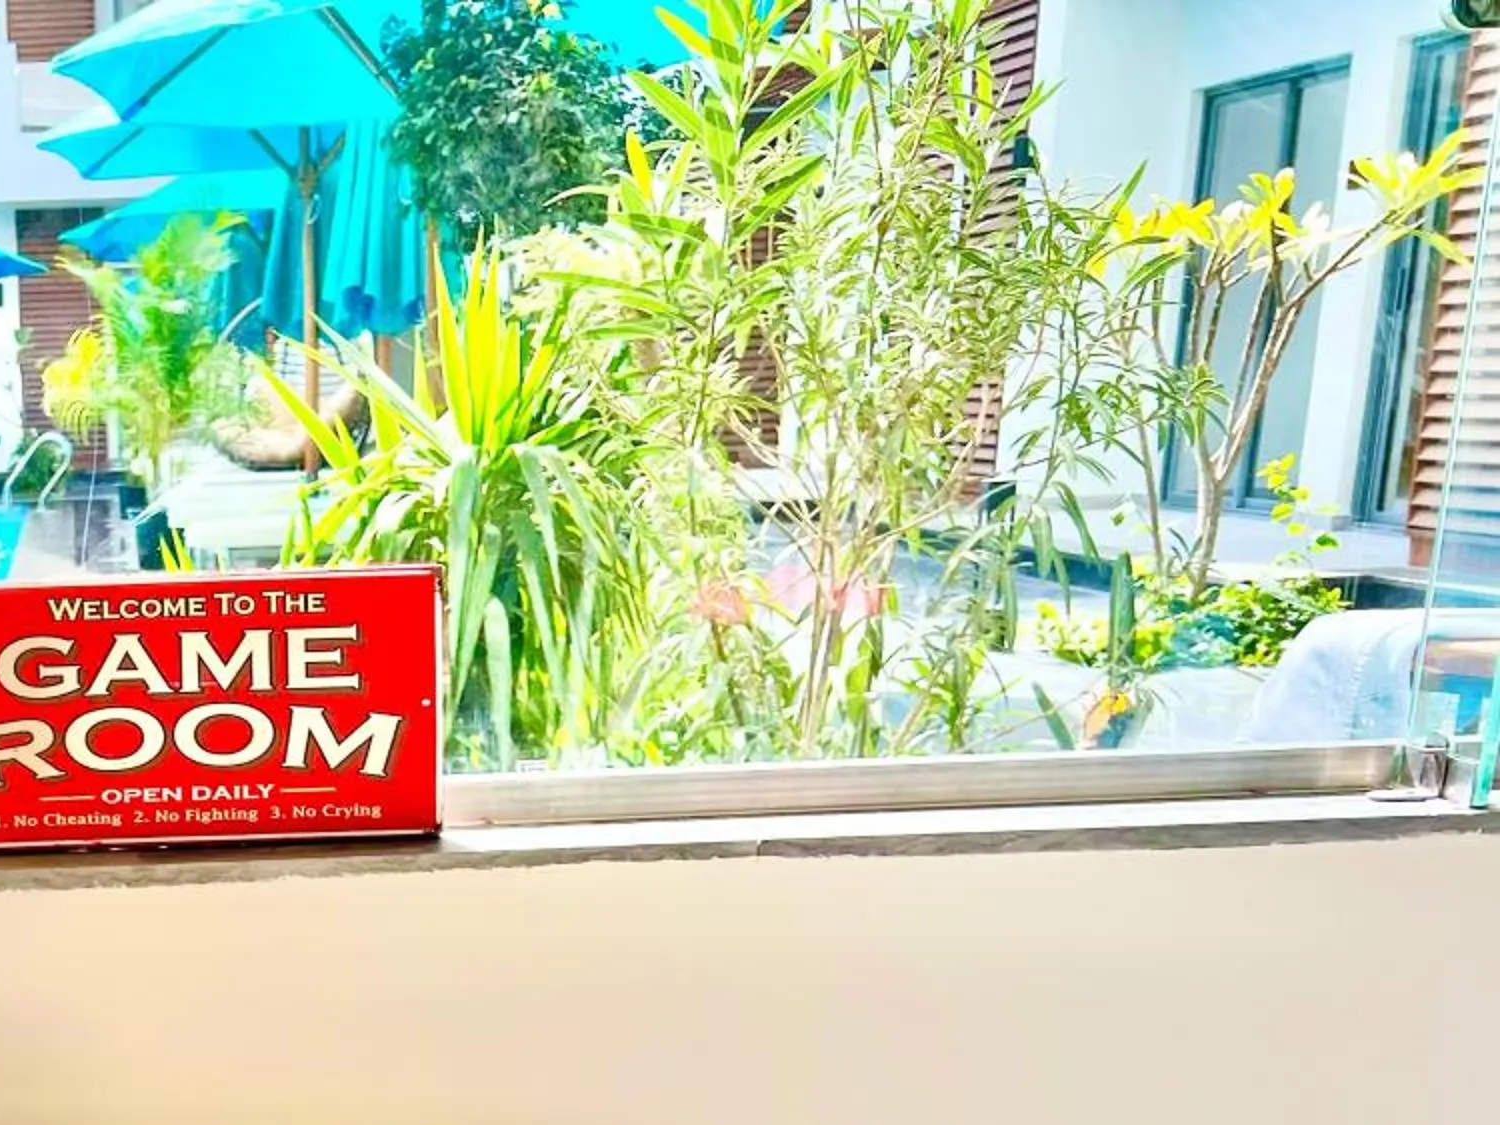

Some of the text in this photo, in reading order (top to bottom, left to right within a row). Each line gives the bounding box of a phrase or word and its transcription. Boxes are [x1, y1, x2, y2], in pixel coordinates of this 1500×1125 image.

[101, 784, 275, 805] OPEN DAILY
[13, 814, 38, 828] No
[43, 811, 122, 827] Cheating
[133, 810, 149, 824] 2.
[155, 809, 180, 823] No
[185, 807, 259, 823] Fighting
[270, 805, 287, 819] 3.
[292, 805, 317, 819] No
[322, 803, 382, 819] Crying
